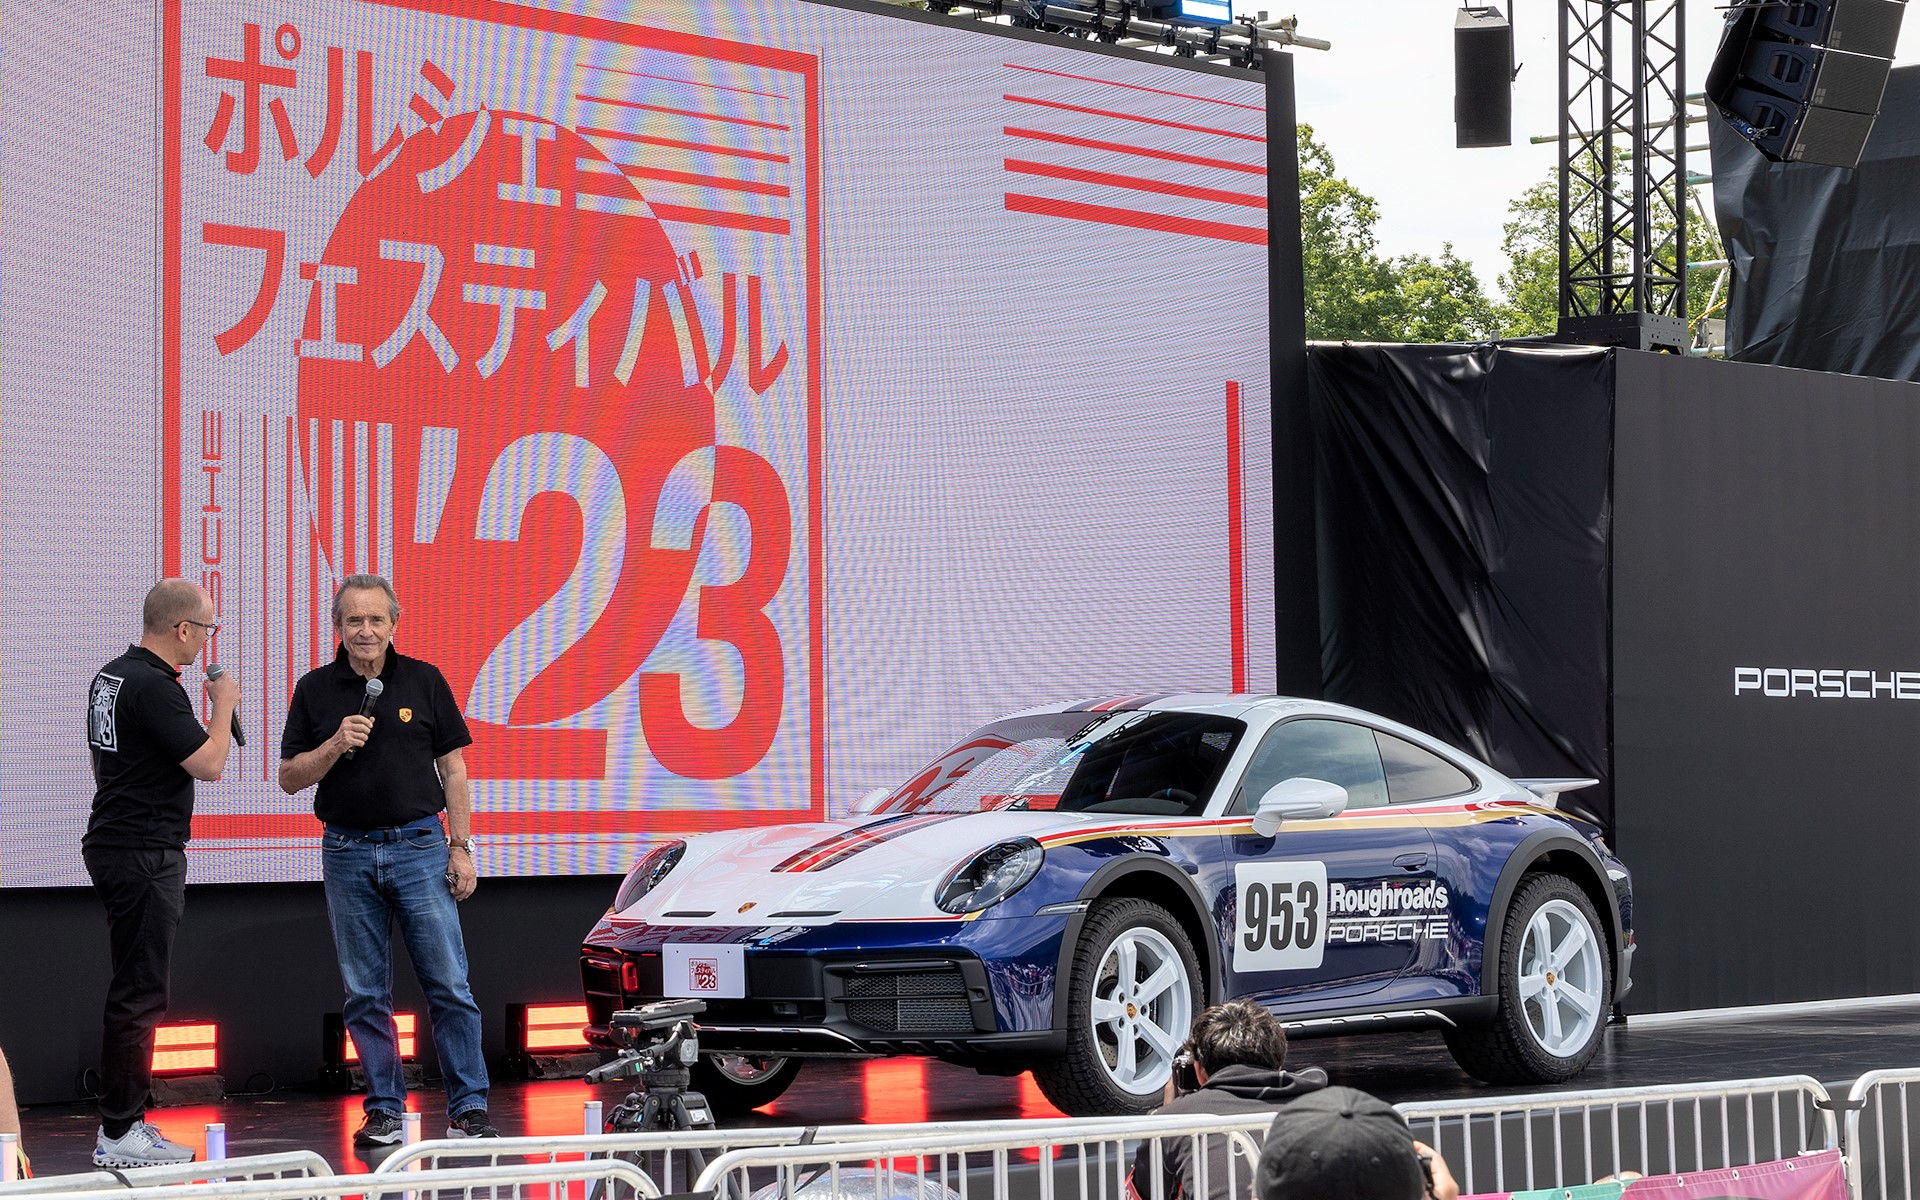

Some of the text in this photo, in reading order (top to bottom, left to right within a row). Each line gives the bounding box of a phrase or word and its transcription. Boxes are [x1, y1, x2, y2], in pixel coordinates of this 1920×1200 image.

[203, 23, 562, 209] ポルシェ
[202, 221, 790, 396] フェスティバル
[1734, 667, 1920, 700] PORSCHE
[1243, 881, 1318, 952] 953
[1330, 880, 1449, 917] Roughroads
[1327, 922, 1449, 944] PORSCHE
